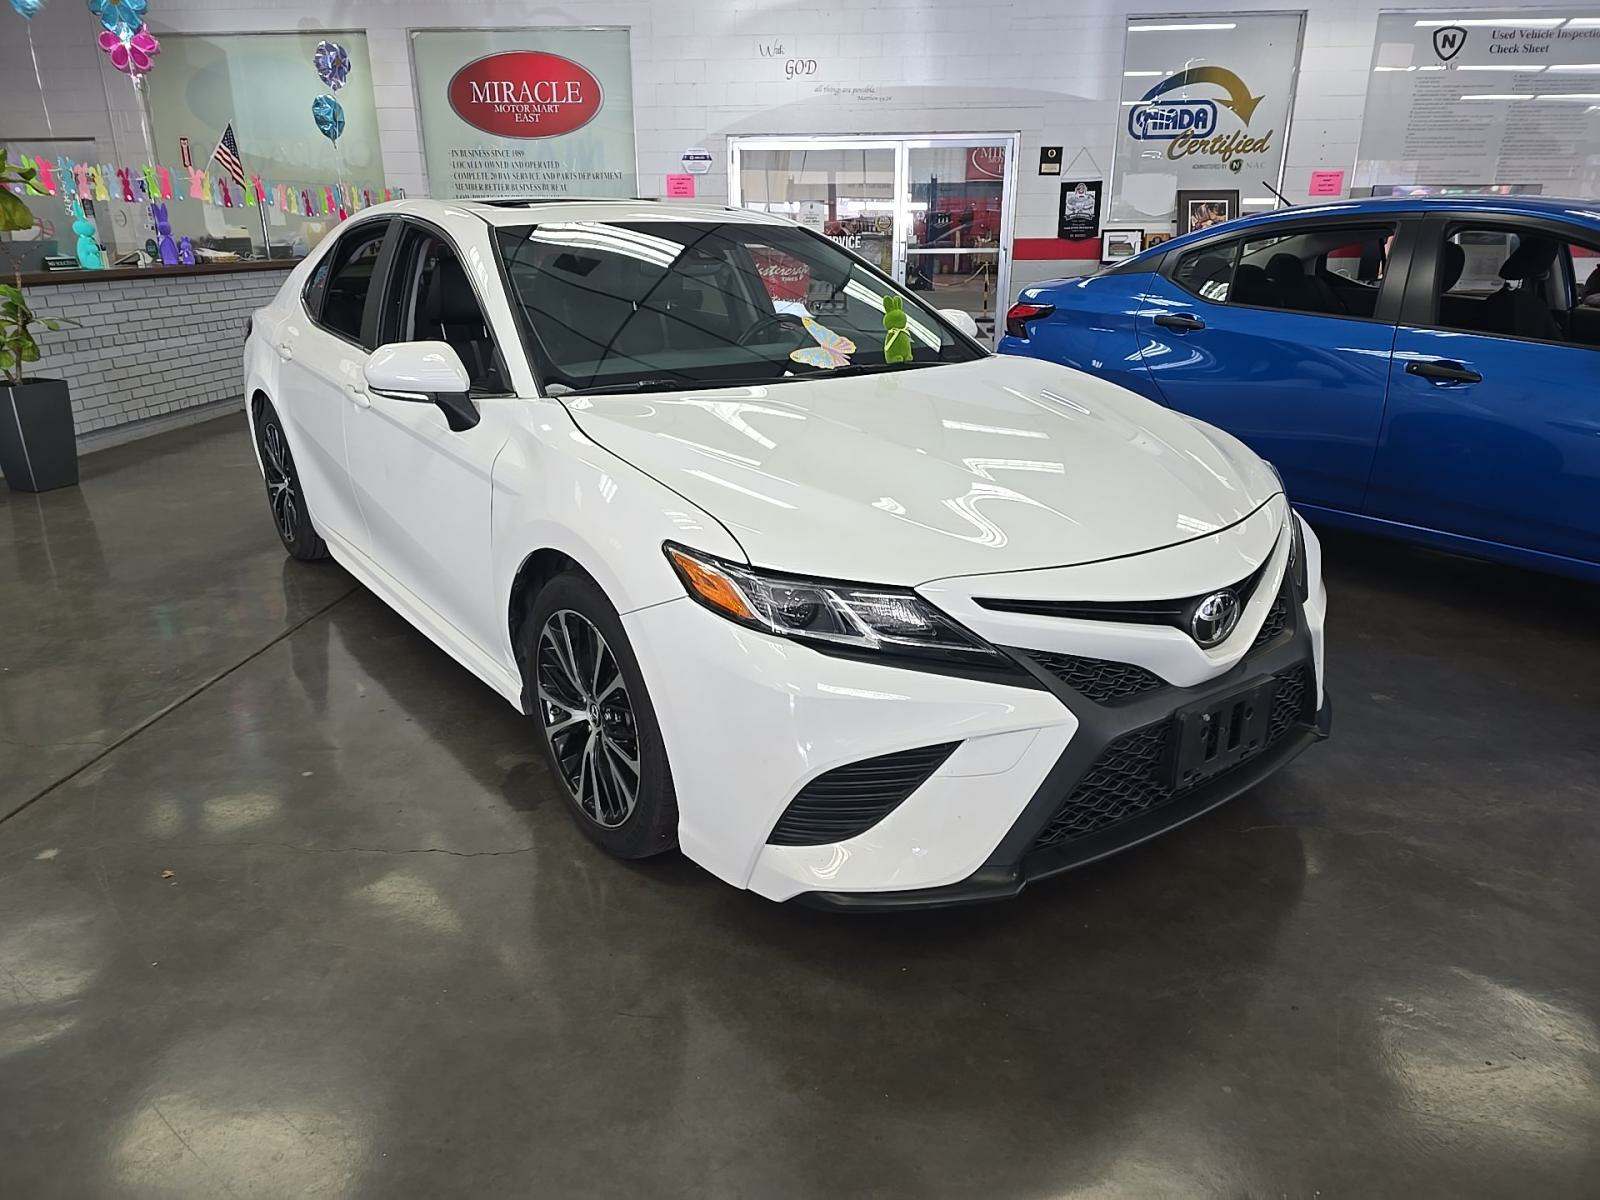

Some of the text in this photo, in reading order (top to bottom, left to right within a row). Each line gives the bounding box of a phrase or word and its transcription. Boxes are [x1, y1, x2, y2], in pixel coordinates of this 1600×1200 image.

[1491, 29, 1515, 40] Used
[1520, 28, 1553, 40] Vehicle
[1489, 43, 1550, 54] Check Sheet
[785, 59, 818, 80] GOD
[469, 80, 583, 104] MIRACLE
[494, 104, 560, 113] MOTOR MART
[515, 113, 541, 123] EAST
[1167, 128, 1274, 163] Certified
[451, 150, 459, 158] IN
[459, 150, 491, 158] BUSINESS
[491, 150, 510, 158] SINCE
[452, 160, 560, 169] LOCALLY OWNED AND OPERATED
[453, 172, 488, 180] COMPLETE
[512, 172, 540, 180] SERVICE
[542, 172, 556, 180] AND
[556, 172, 578, 180] PARTS
[578, 172, 622, 180] DEPARTMENT
[829, 235, 862, 249] RVICE
